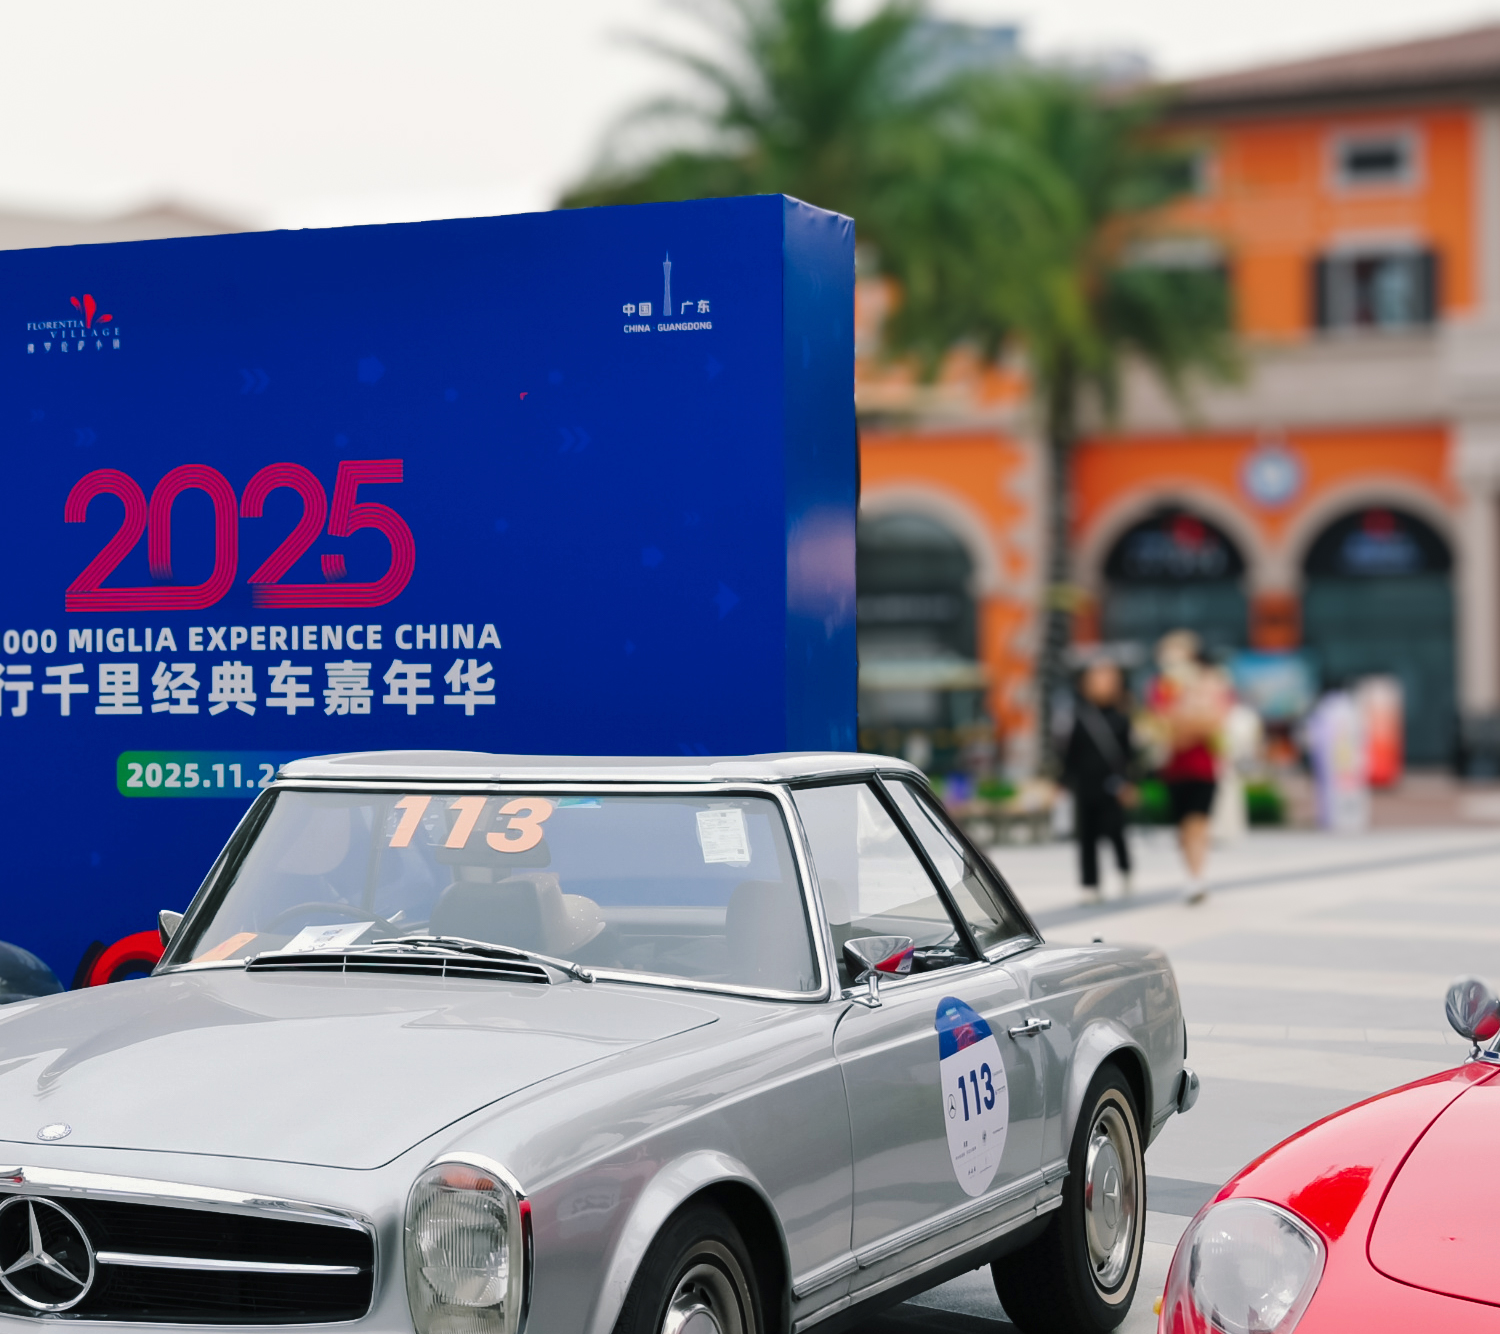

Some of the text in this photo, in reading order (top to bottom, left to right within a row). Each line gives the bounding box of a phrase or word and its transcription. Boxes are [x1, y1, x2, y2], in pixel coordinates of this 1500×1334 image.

[622, 299, 711, 317] 中国 广东
[26, 319, 85, 331] FLORENTIA
[50, 326, 120, 339] VILLAGE
[623, 321, 713, 334] CHINA GUANGDONG
[64, 458, 416, 613] 2025
[68, 627, 176, 654] MIGLIA
[188, 624, 383, 653] EXPERIENCE
[394, 623, 502, 651] CHINA
[126, 762, 287, 789] 2025.11.2
[388, 795, 554, 854] 113
[957, 1062, 996, 1122] 113
